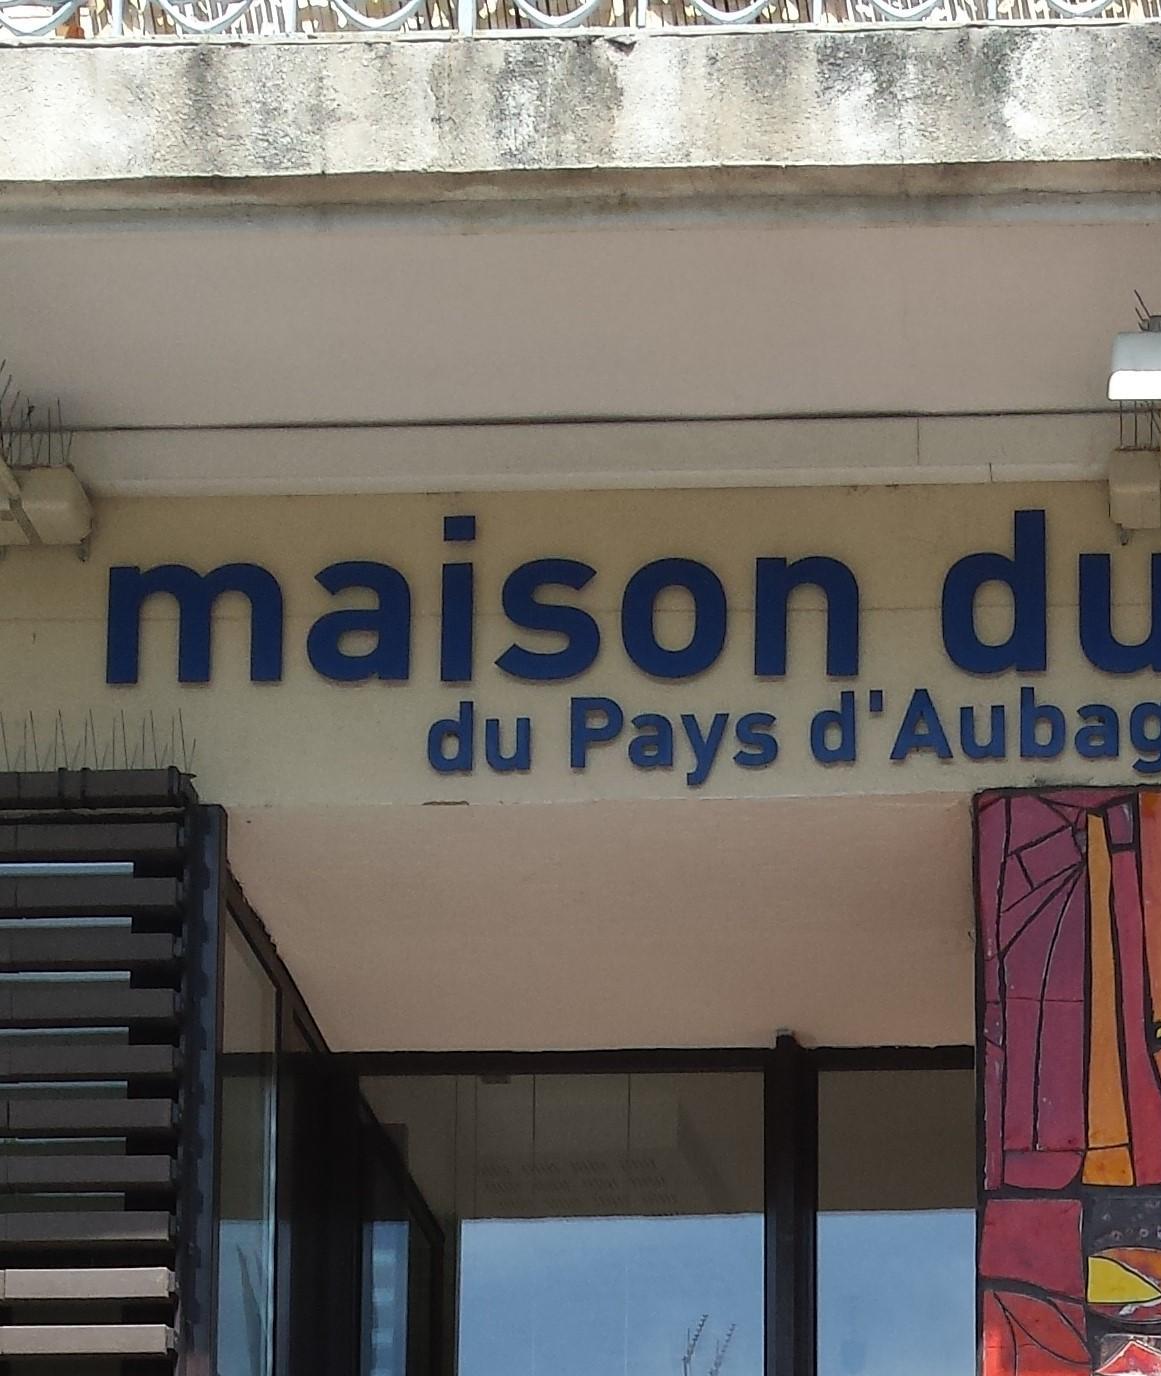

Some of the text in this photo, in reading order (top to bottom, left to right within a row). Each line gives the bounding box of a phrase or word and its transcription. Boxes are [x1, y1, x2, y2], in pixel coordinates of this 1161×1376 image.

[107, 516, 859, 683] maison
[428, 701, 532, 774] du
[570, 697, 778, 784] Pays
